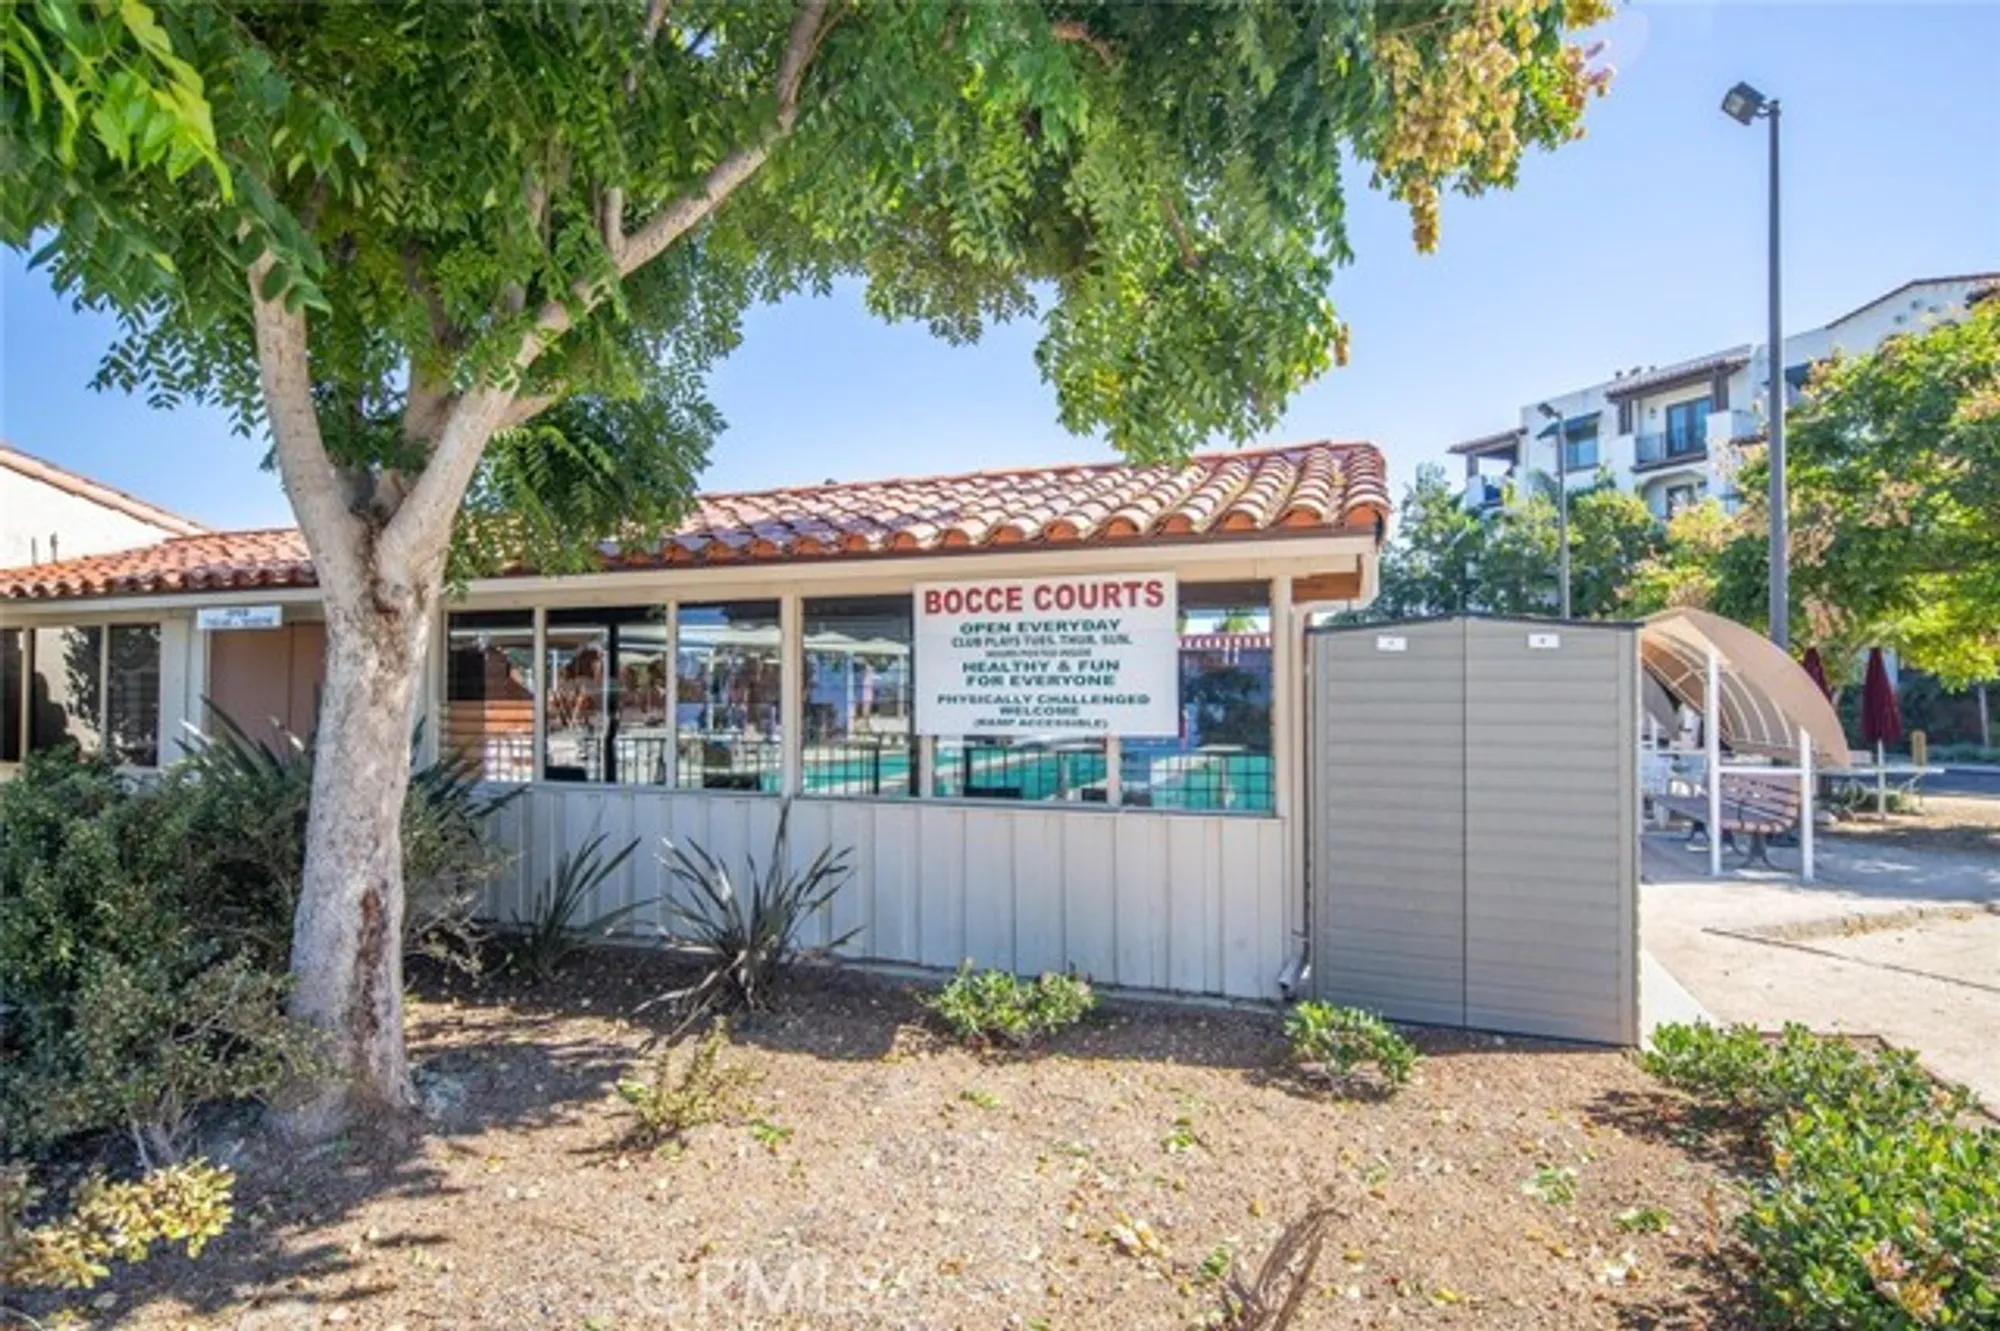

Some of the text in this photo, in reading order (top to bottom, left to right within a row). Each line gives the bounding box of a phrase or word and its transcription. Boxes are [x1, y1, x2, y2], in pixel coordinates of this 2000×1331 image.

[924, 580, 1165, 614] BOCCE COURTS
[959, 619, 1121, 635] OPEN EVERYDAY
[952, 636, 982, 648] CLUB
[984, 635, 1020, 647] PLAYS
[962, 660, 1120, 673] HEALTHY & FUN
[966, 675, 1116, 687] FOR EVERYONE
[937, 694, 1151, 705] PHYSICALLY CHALLENGED
[1000, 706, 1080, 716] WELCOME
[974, 718, 1109, 729] (RAMP ACCESSIBLE)
